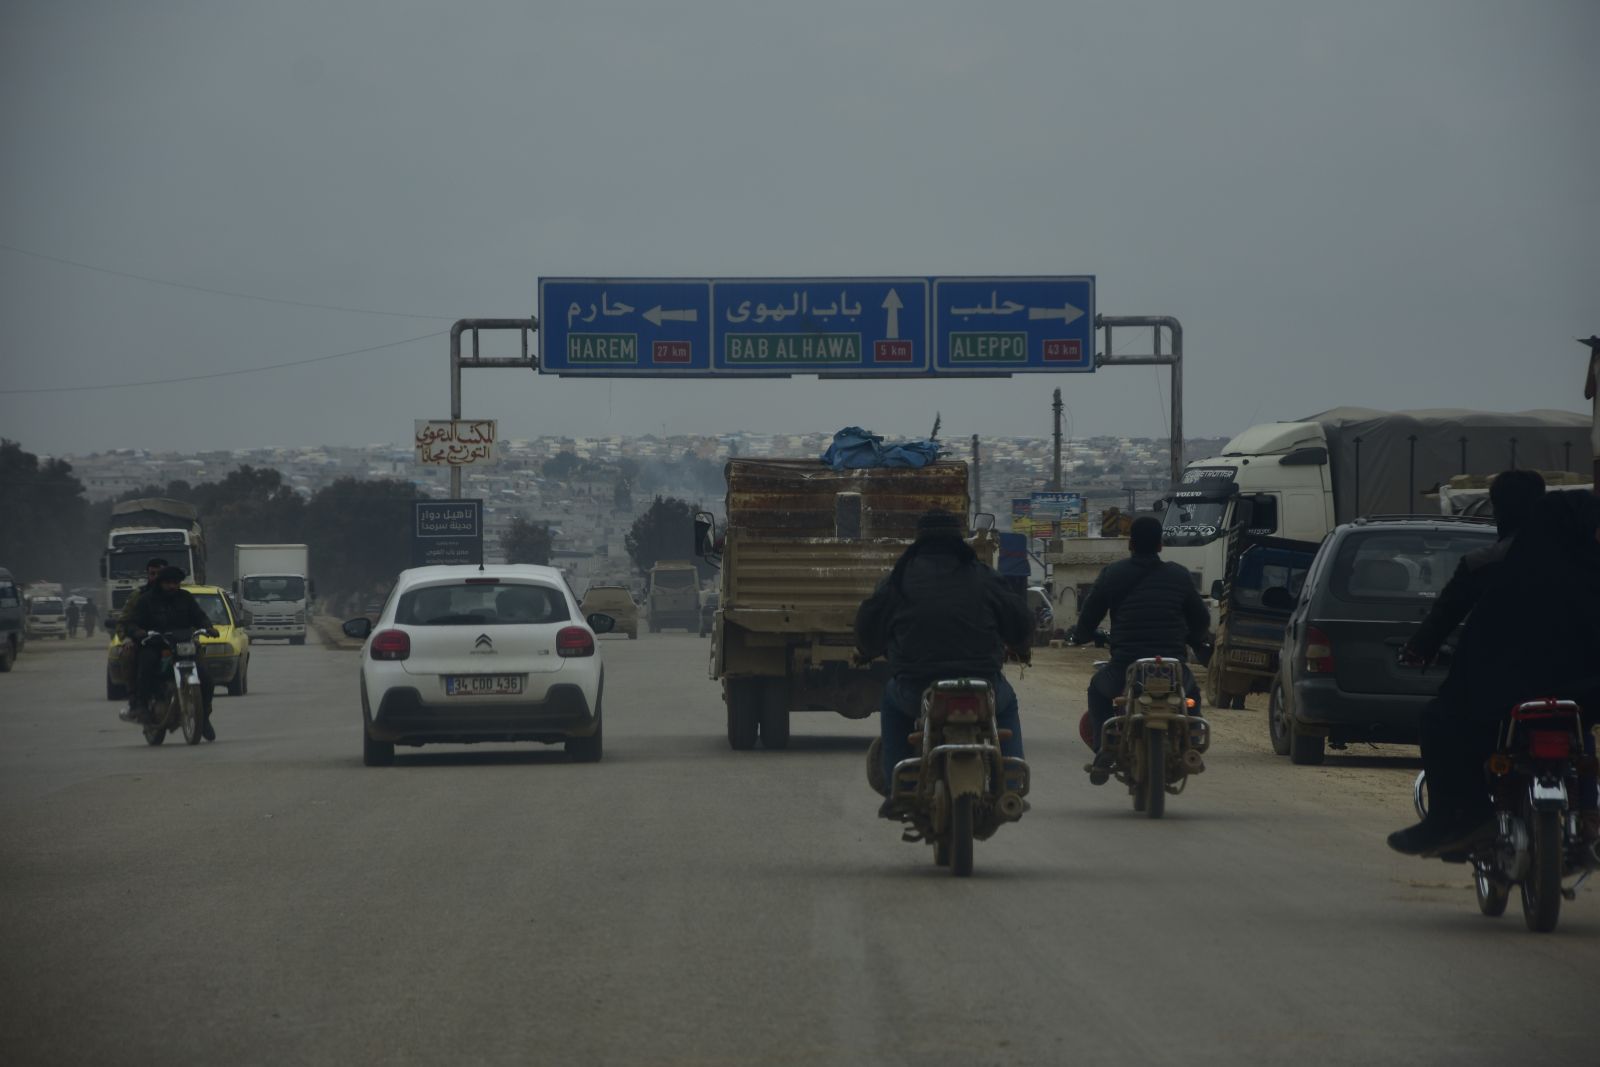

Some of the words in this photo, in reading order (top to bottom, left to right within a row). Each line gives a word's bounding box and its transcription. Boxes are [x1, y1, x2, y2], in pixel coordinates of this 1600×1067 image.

[567, 291, 635, 329] حارم
[726, 291, 807, 323] الهوى
[812, 291, 862, 323] باب
[951, 290, 1025, 322] حلب
[570, 338, 634, 359] HAREM
[657, 346, 667, 357] 27
[672, 346, 687, 357] km
[731, 338, 768, 359] BAB
[880, 345, 886, 356] 5
[891, 344, 906, 356] km
[953, 337, 1023, 357] ALEPPO
[1047, 344, 1059, 355] 43
[1062, 344, 1078, 355] km
[454, 679, 468, 690] 34
[497, 677, 518, 689] 436
